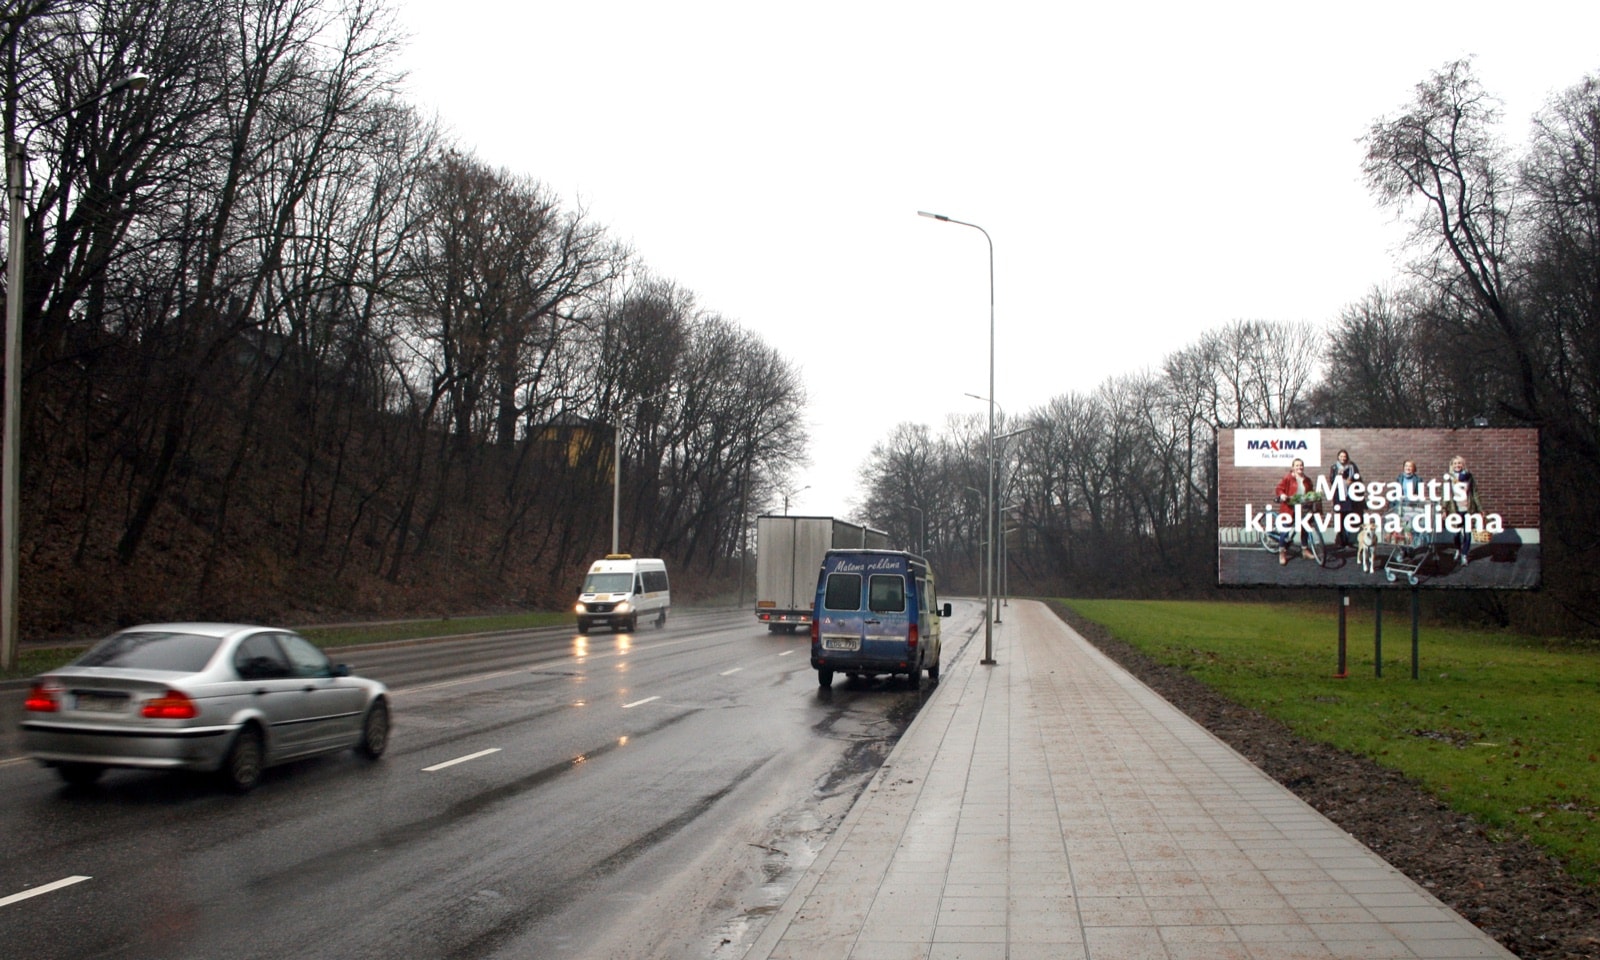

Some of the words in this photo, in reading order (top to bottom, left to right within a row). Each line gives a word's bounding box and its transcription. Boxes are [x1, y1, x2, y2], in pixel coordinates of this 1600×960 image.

[1247, 439, 1308, 451] MAXIMA
[1315, 473, 1468, 510] Mėgautis
[1245, 504, 1405, 533] kiekviena
[1412, 504, 1504, 533] diena
[867, 558, 900, 570] reklama
